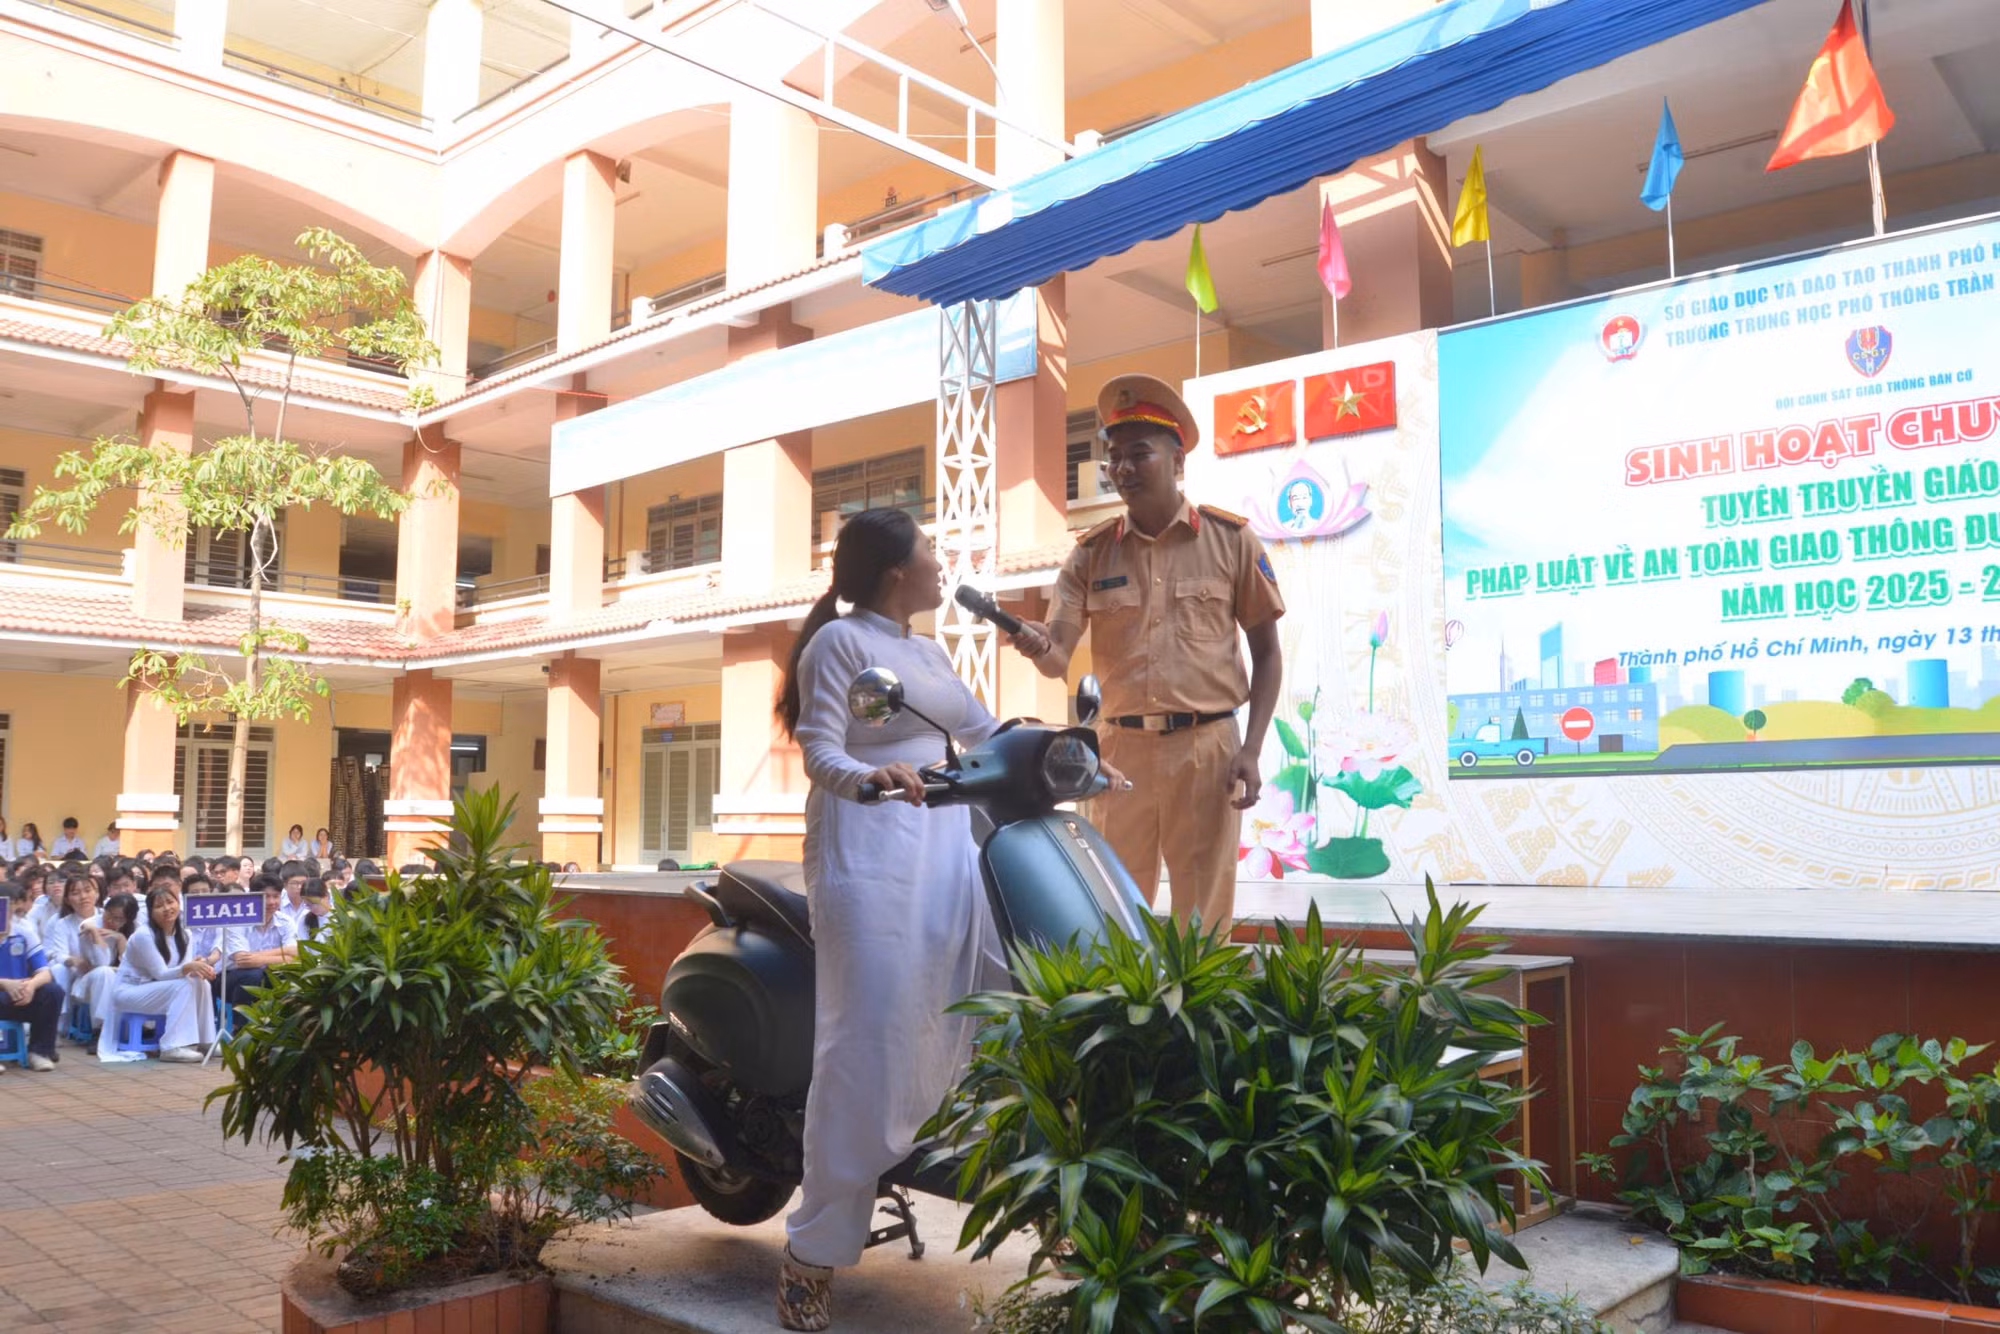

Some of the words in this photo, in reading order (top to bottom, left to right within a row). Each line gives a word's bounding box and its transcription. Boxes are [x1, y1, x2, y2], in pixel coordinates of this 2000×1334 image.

[1734, 310, 1791, 335] TRUNG
[1797, 302, 1832, 325] HỌC
[1625, 435, 1735, 486] SINH
[1741, 413, 1880, 470] HOẠT
[1702, 485, 1791, 526] TUYÊN
[1799, 465, 1914, 515] TRUYỀN
[1923, 458, 2000, 502] GIÁO
[1466, 562, 1529, 598] PHÁP
[1536, 553, 1597, 595] LUẬT
[1604, 544, 1637, 584] VỀ
[1642, 546, 1680, 582] AN
[1686, 537, 1762, 578] TOÀN
[1769, 529, 1842, 569] GIAO
[1848, 518, 1956, 560] THÔNG
[1721, 583, 1787, 621] NĂM
[1795, 577, 1859, 619] HỌC
[1866, 570, 1952, 611] 2025
[1619, 648, 1677, 667] Thành
[1683, 641, 1727, 666] phố
[1730, 637, 1758, 659] Hồ
[1766, 637, 1805, 657] Chí
[1810, 635, 1868, 654] Minh,
[1878, 629, 1937, 653] ngày
[1947, 626, 1972, 645] 13
[191, 902, 257, 919] 11A11
